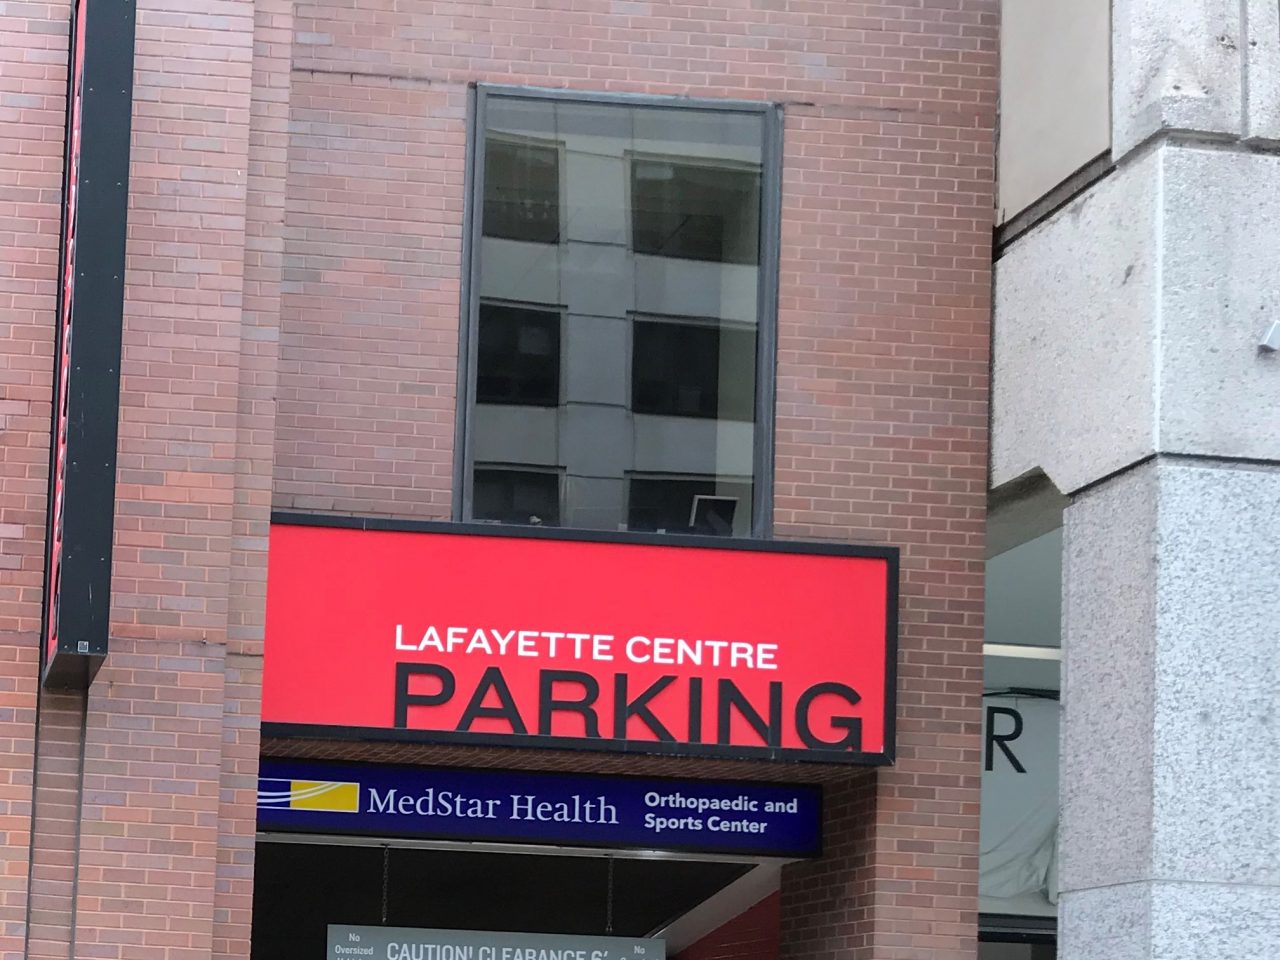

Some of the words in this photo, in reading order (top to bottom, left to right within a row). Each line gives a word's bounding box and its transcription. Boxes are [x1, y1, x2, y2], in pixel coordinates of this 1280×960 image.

[395, 624, 614, 661] LAFAYETTE
[626, 635, 778, 669] CENTRE
[394, 662, 862, 752] PARKING
[367, 788, 501, 818] MedStar
[510, 795, 619, 824] Health
[644, 792, 758, 813] Orthopaedic
[764, 799, 797, 813] and
[644, 813, 702, 832] Sports
[707, 816, 767, 833] Center
[349, 933, 360, 942] No
[335, 944, 373, 955] Oversized
[634, 945, 645, 955] No
